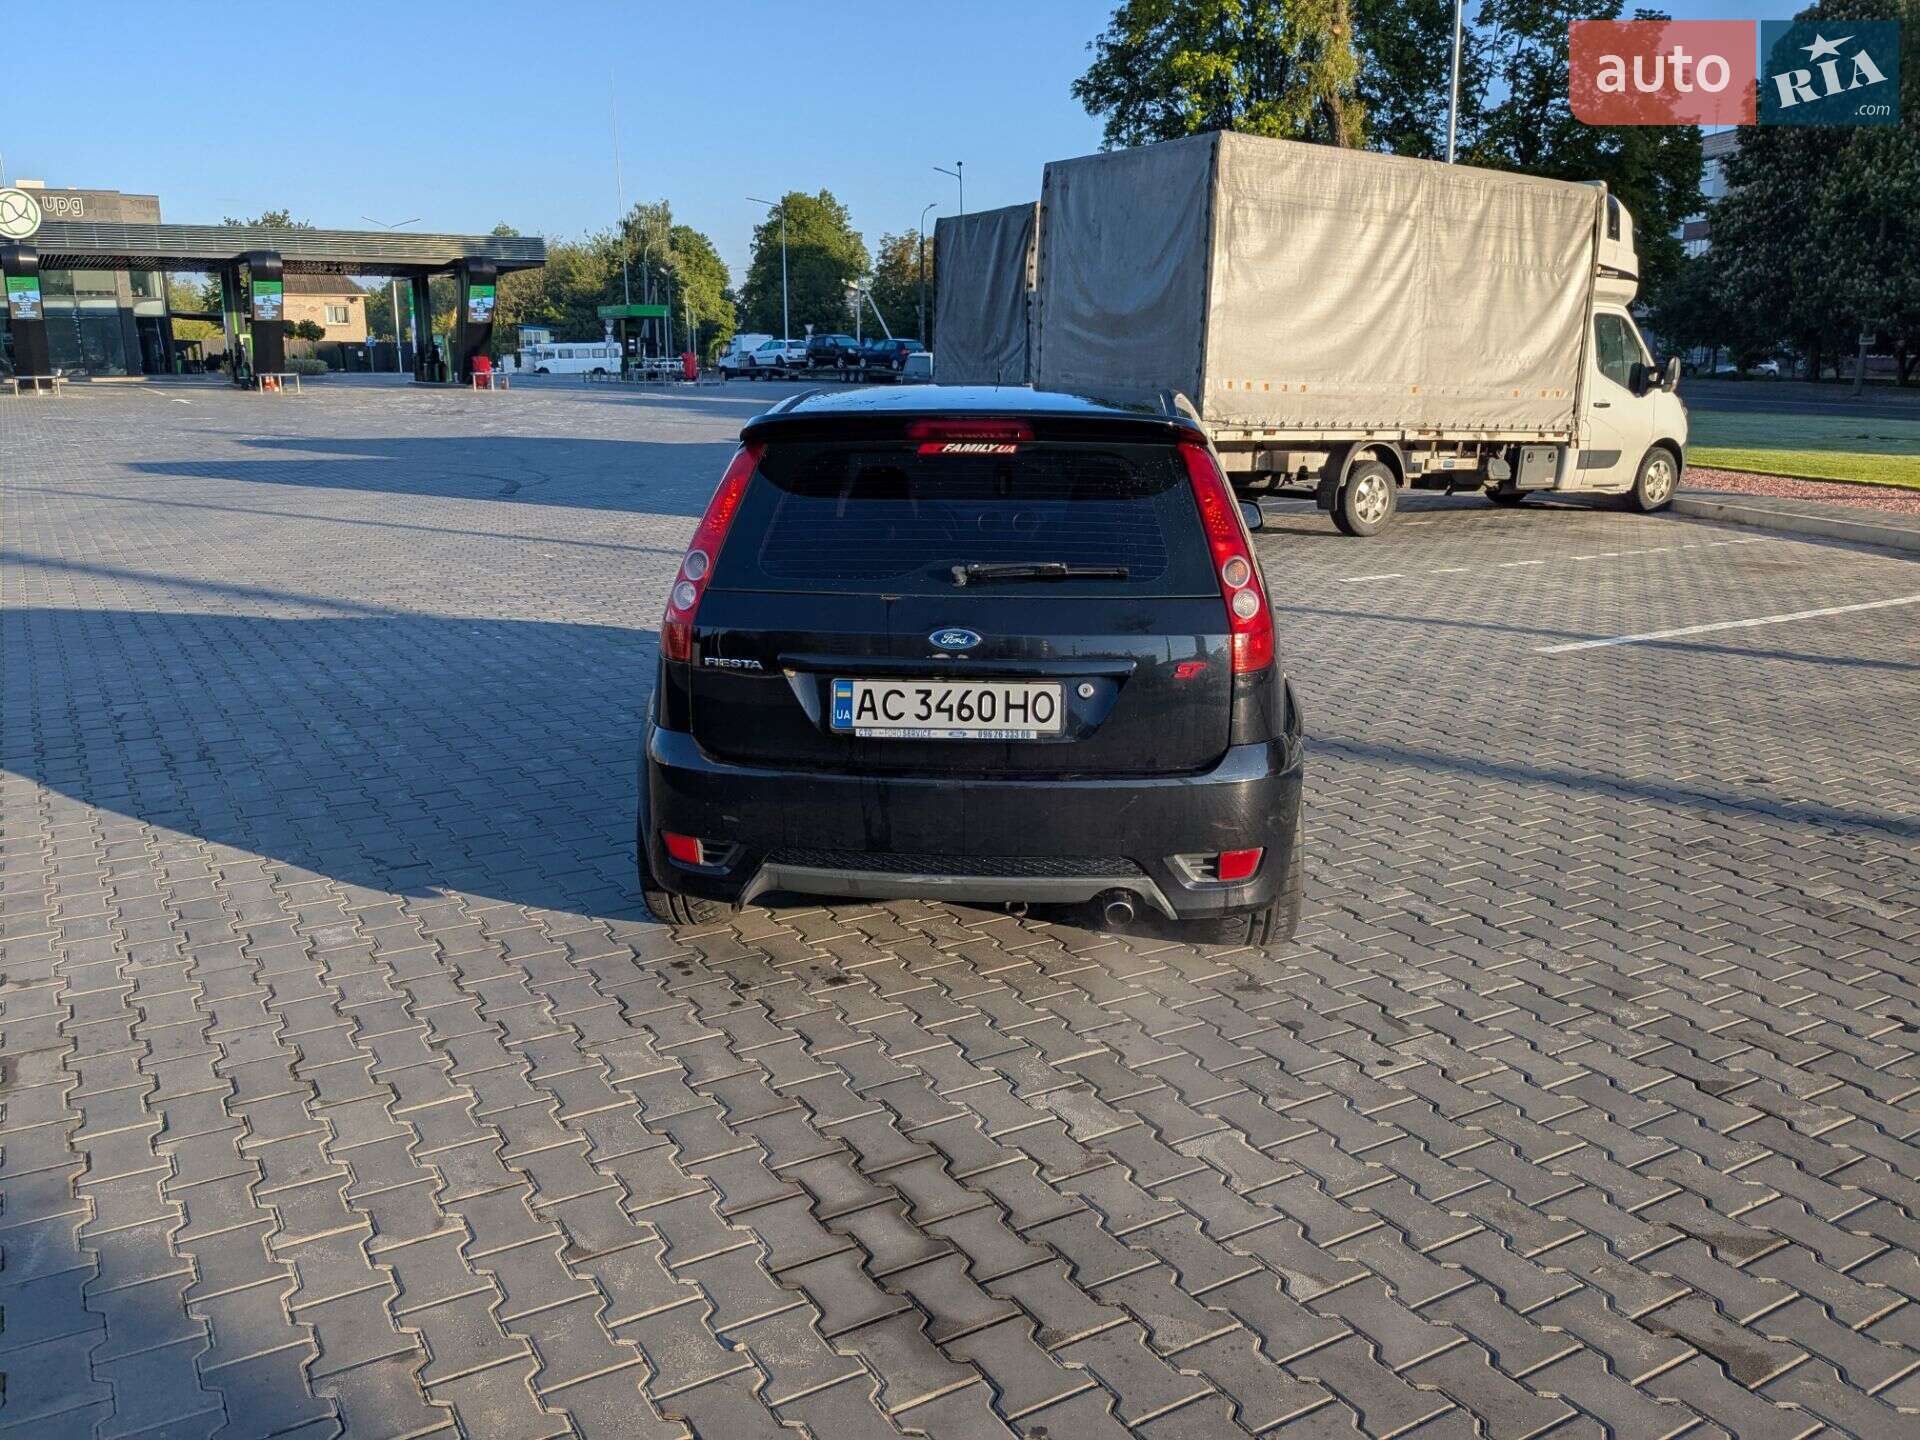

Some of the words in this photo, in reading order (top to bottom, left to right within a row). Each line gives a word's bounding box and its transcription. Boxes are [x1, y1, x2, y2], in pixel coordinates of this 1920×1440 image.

[41, 196, 84, 217] upg
[941, 443, 998, 453] FAMILY
[940, 632, 969, 644] Ford
[704, 657, 763, 670] FIESTA
[1173, 661, 1207, 680] ST
[836, 709, 851, 720] UA
